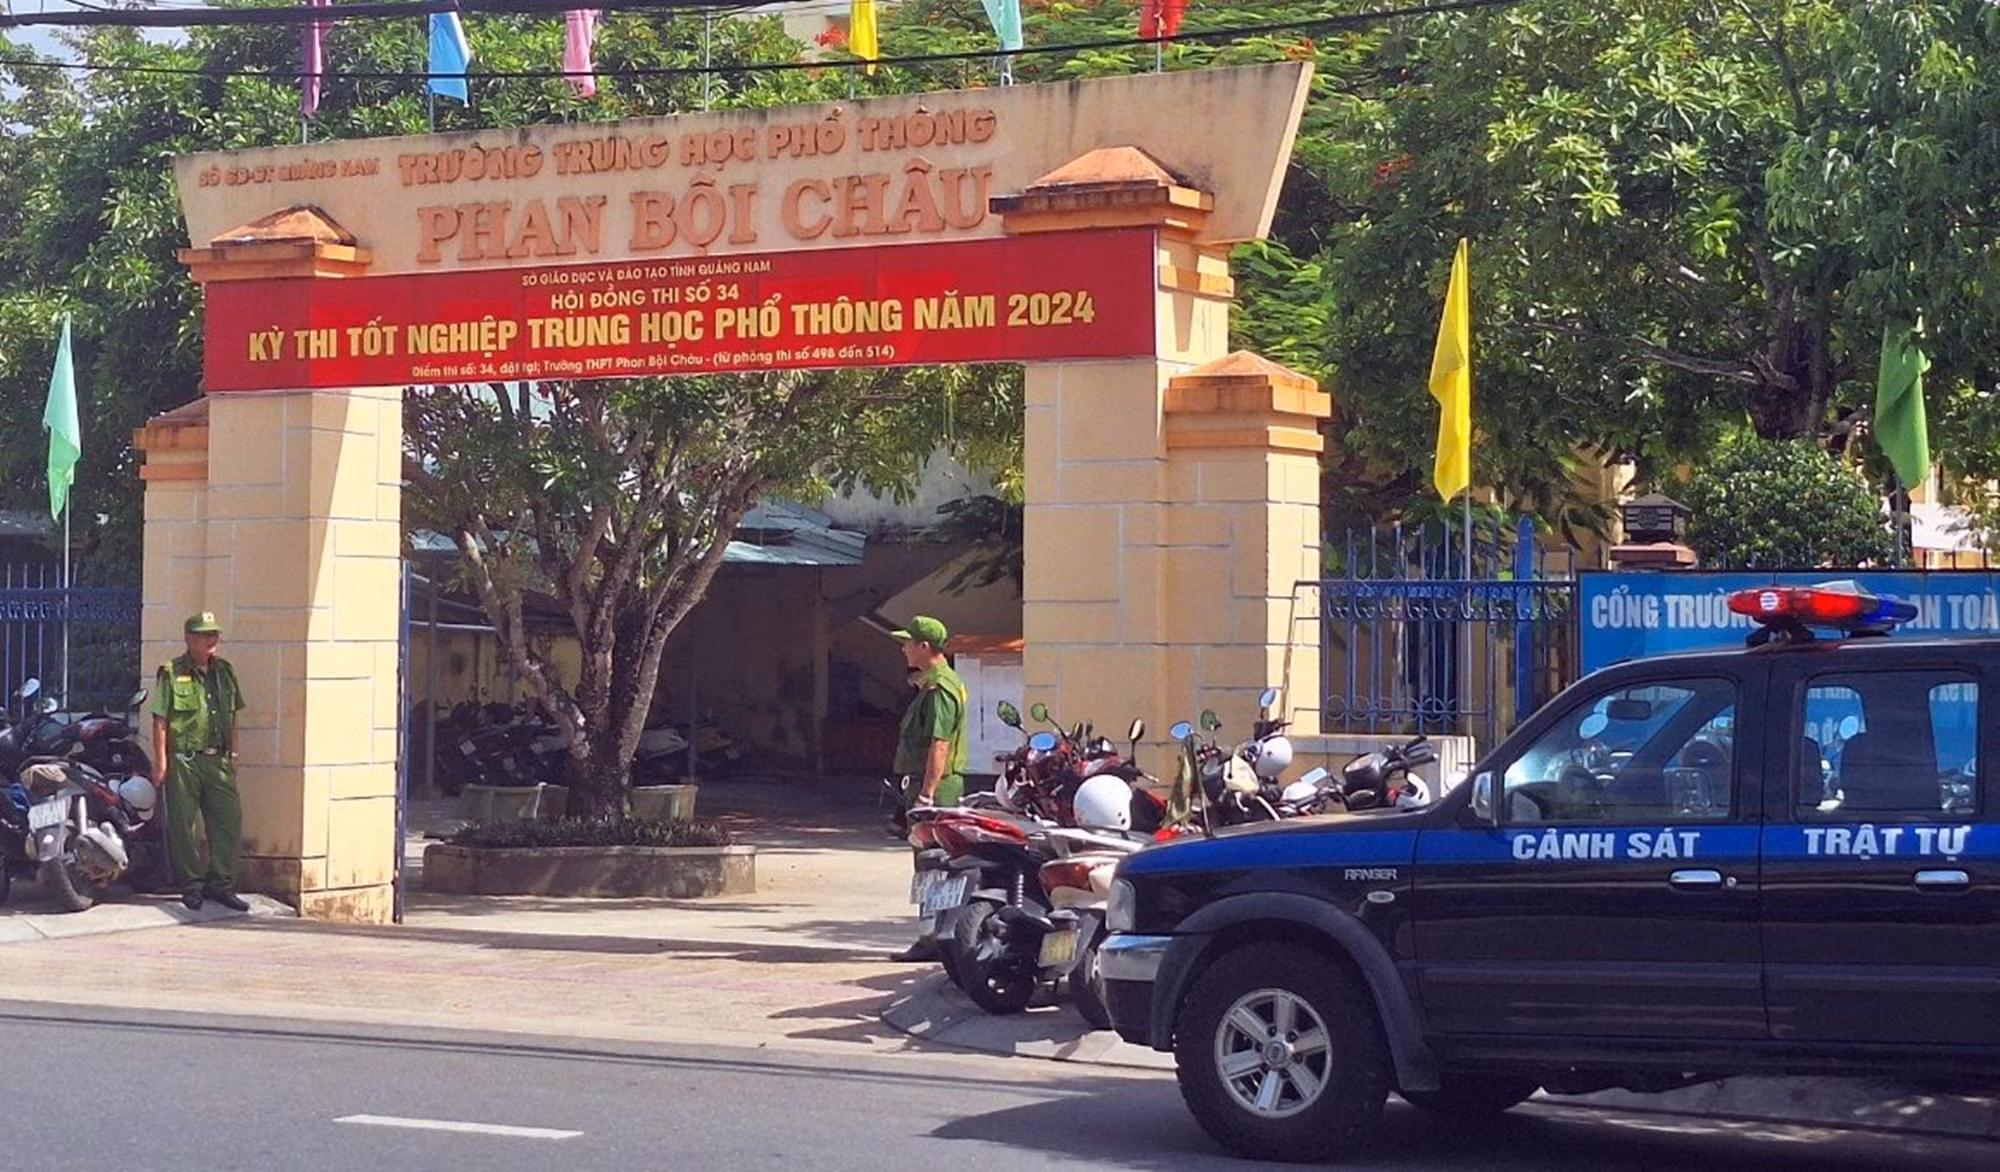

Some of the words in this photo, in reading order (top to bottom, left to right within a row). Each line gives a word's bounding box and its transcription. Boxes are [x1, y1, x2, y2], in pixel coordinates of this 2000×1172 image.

[398, 141, 544, 187] TRƯỜNG
[553, 133, 670, 175] TRUNG
[680, 128, 756, 170] HỌC
[767, 106, 846, 159] PHỔ
[857, 104, 996, 152] THÔNG
[340, 157, 381, 177] NAM
[416, 195, 607, 264] PHAN
[628, 171, 758, 258] BỘI
[782, 156, 993, 241] CHÂU
[571, 271, 596, 286] DỤC
[598, 267, 614, 282] VÀ
[617, 265, 642, 281] ĐÀO
[644, 266, 668, 282] TẠO
[698, 260, 741, 276] QUẢNG
[744, 260, 771, 273] NAM
[551, 289, 584, 314] HỘI
[590, 283, 646, 309] ĐỒNG
[652, 287, 679, 305] THI
[685, 279, 711, 303] SỐ
[716, 284, 739, 301] 34
[249, 325, 285, 361] KỲ
[294, 328, 337, 359] THI
[347, 316, 398, 357] TỐT
[407, 315, 518, 358] NGHIỆP
[528, 313, 631, 349] TRUNG
[640, 309, 704, 349] HỌC
[715, 293, 781, 340] PHỔ
[791, 296, 902, 336] THÔNG
[914, 289, 996, 330] NĂM
[1007, 291, 1095, 327] 2024
[443, 364, 458, 376] thi
[460, 362, 477, 376] số:
[543, 359, 583, 374] Trường
[586, 357, 613, 370] THPT
[615, 356, 646, 368] Phan
[648, 354, 667, 369] Bội
[670, 352, 703, 366] Châu
[733, 349, 773, 366] phòng
[776, 348, 792, 361] thi
[795, 345, 810, 360] số
[811, 346, 836, 359] 498
[866, 344, 895, 359] 514)
[1591, 584, 1659, 629] CỔNG
[1512, 828, 1615, 860] CẢNH
[1626, 827, 1701, 859] SÁT
[1803, 824, 1902, 860] TRẬT
[1914, 824, 1972, 861] TỰ
[1344, 868, 1398, 881] RANGER
